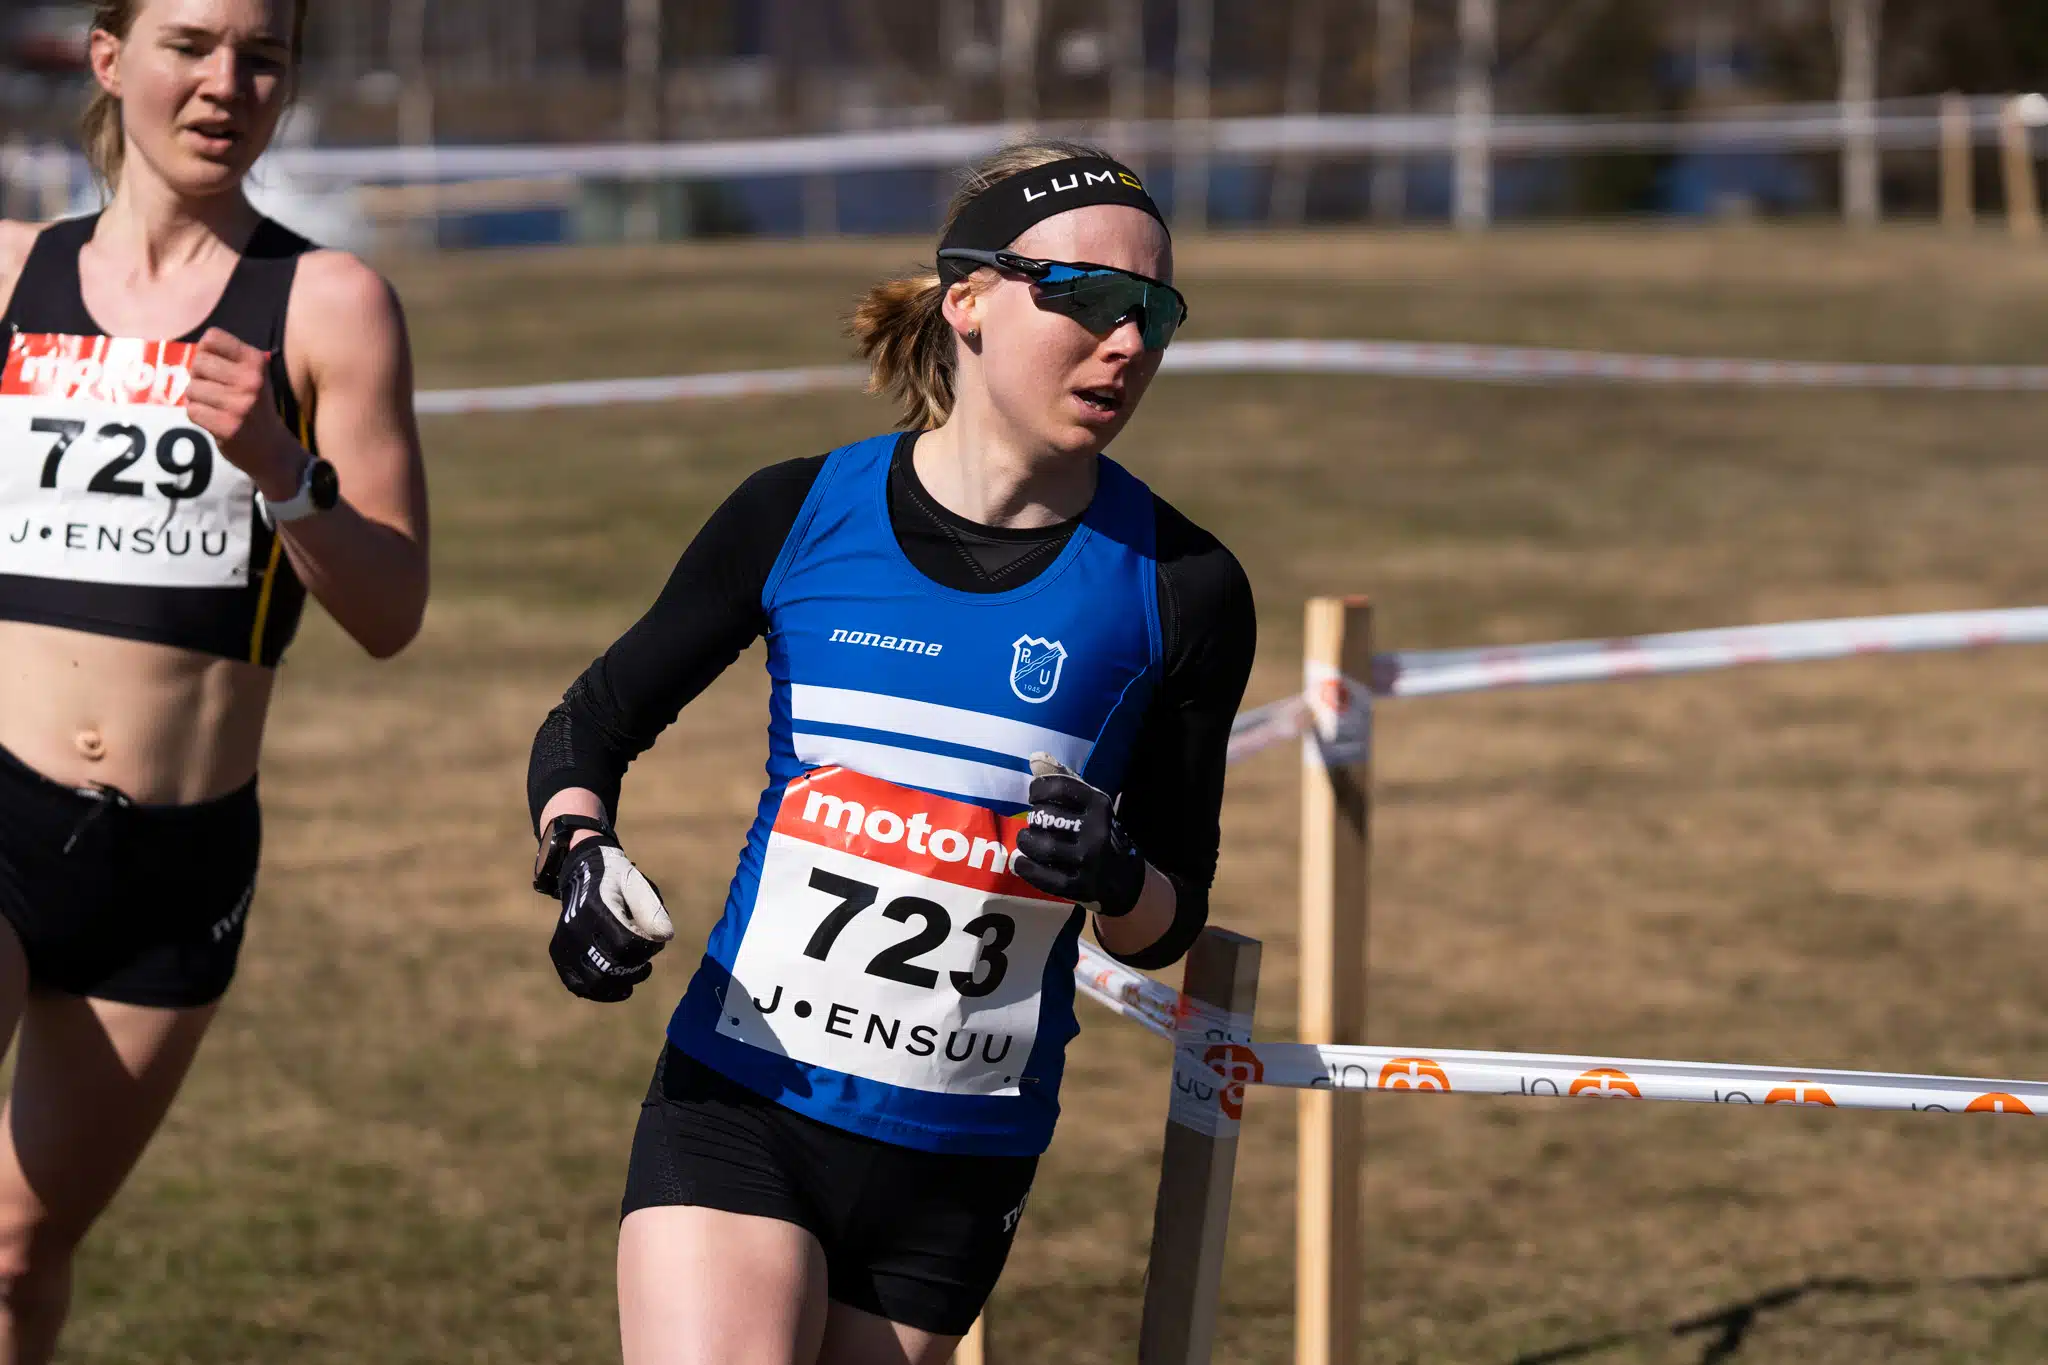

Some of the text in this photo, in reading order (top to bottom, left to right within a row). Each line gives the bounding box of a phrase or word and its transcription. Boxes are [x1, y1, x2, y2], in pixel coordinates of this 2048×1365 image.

[1023, 169, 1146, 203] LUMO
[30, 416, 214, 499] 729
[828, 628, 944, 657] noname
[1023, 683, 1041, 694] 1945
[802, 866, 1016, 998] 723
